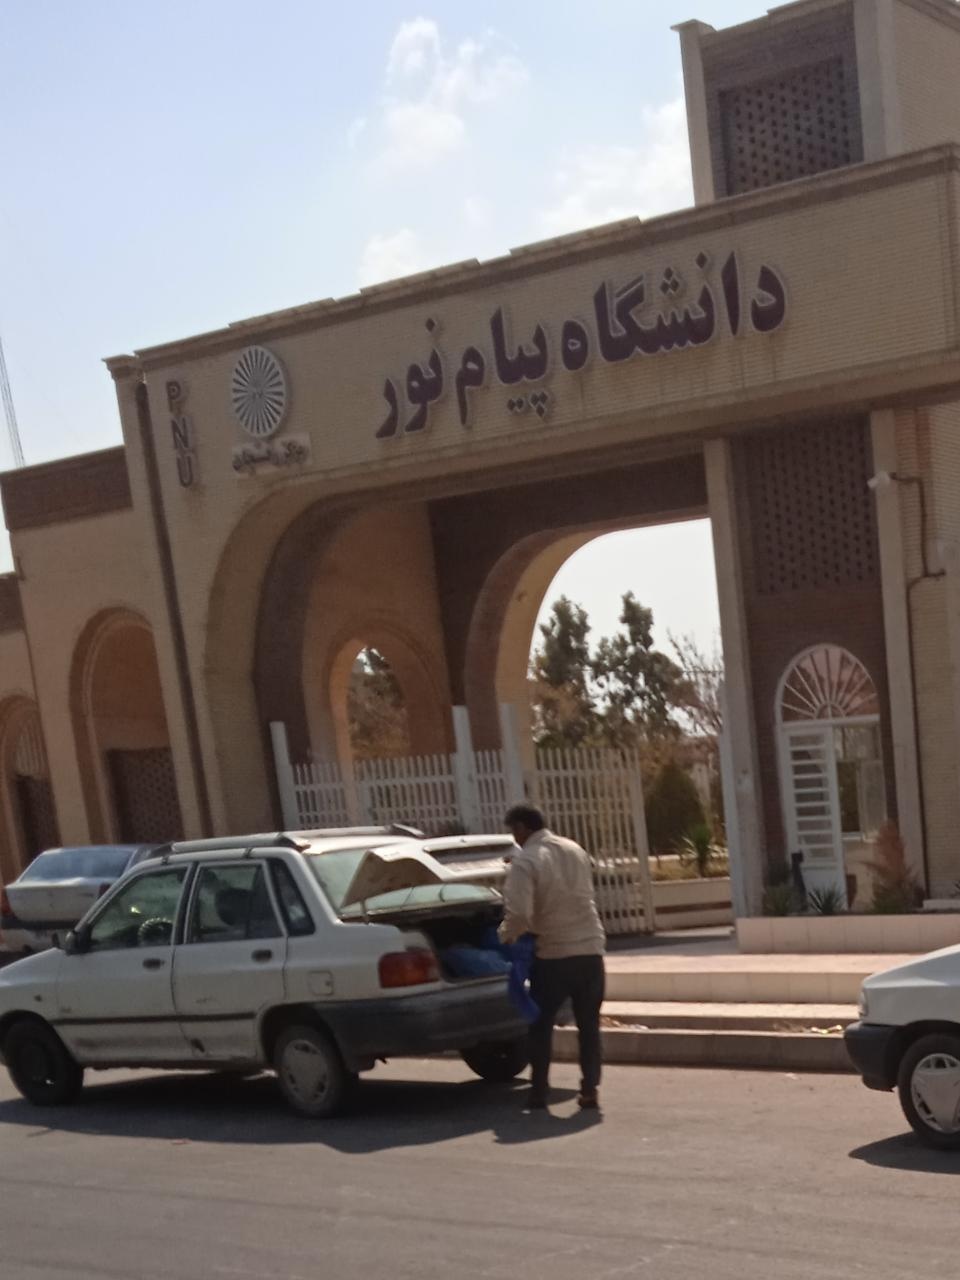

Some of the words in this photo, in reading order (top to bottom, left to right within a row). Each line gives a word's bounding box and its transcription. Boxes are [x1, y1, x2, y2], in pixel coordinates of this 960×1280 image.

[454, 305, 549, 427] پیام
[561, 250, 786, 371] دانشگاه
[375, 316, 444, 439] نور
